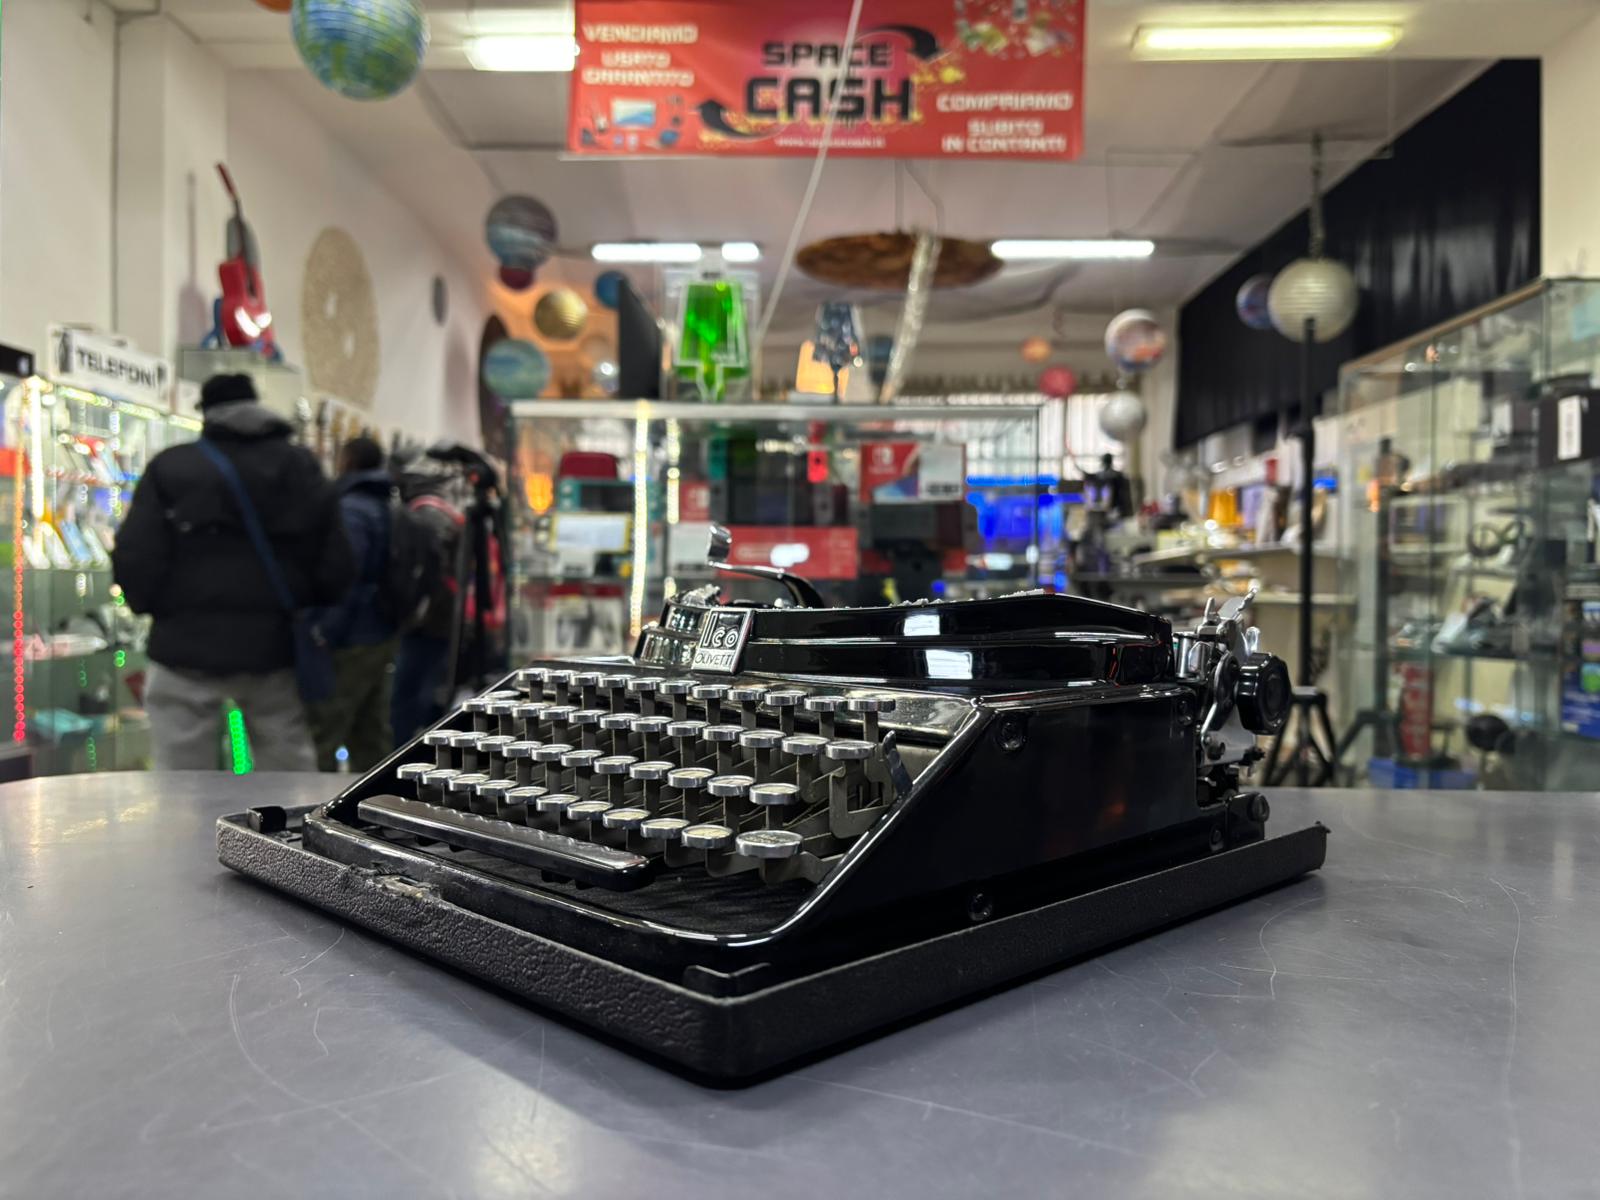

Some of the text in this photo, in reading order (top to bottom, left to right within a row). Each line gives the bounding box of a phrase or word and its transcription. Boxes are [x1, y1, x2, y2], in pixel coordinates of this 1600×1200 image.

[582, 24, 698, 44] VENDIAMO
[763, 43, 889, 67] SPACE
[746, 77, 912, 123] CASH
[936, 91, 1074, 112] COMPRIAMO
[77, 346, 157, 389] TELEFONI
[694, 651, 733, 667] OLIVETTI
